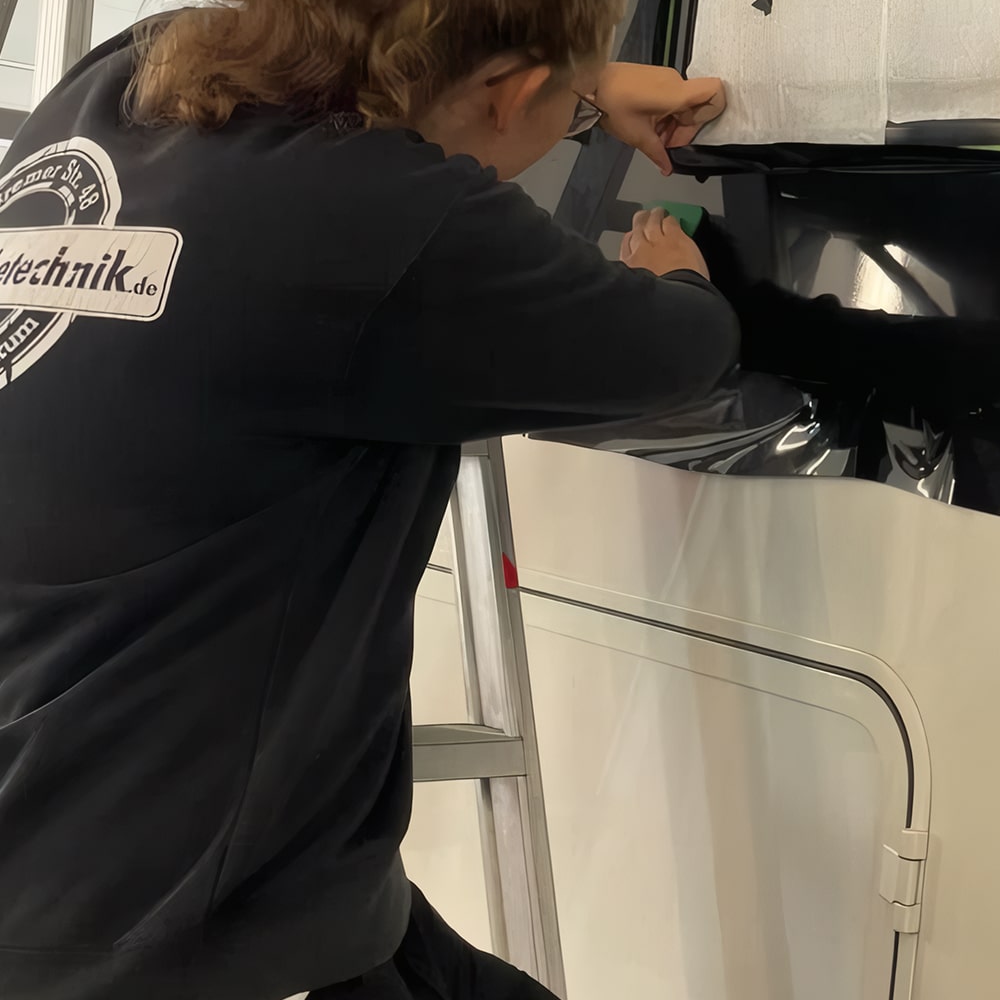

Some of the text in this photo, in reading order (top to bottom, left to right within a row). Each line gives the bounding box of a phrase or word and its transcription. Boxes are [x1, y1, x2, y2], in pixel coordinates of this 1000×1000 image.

[0, 165, 62, 205] remer
[79, 183, 99, 211] 48
[0, 246, 157, 296] etechnik.de
